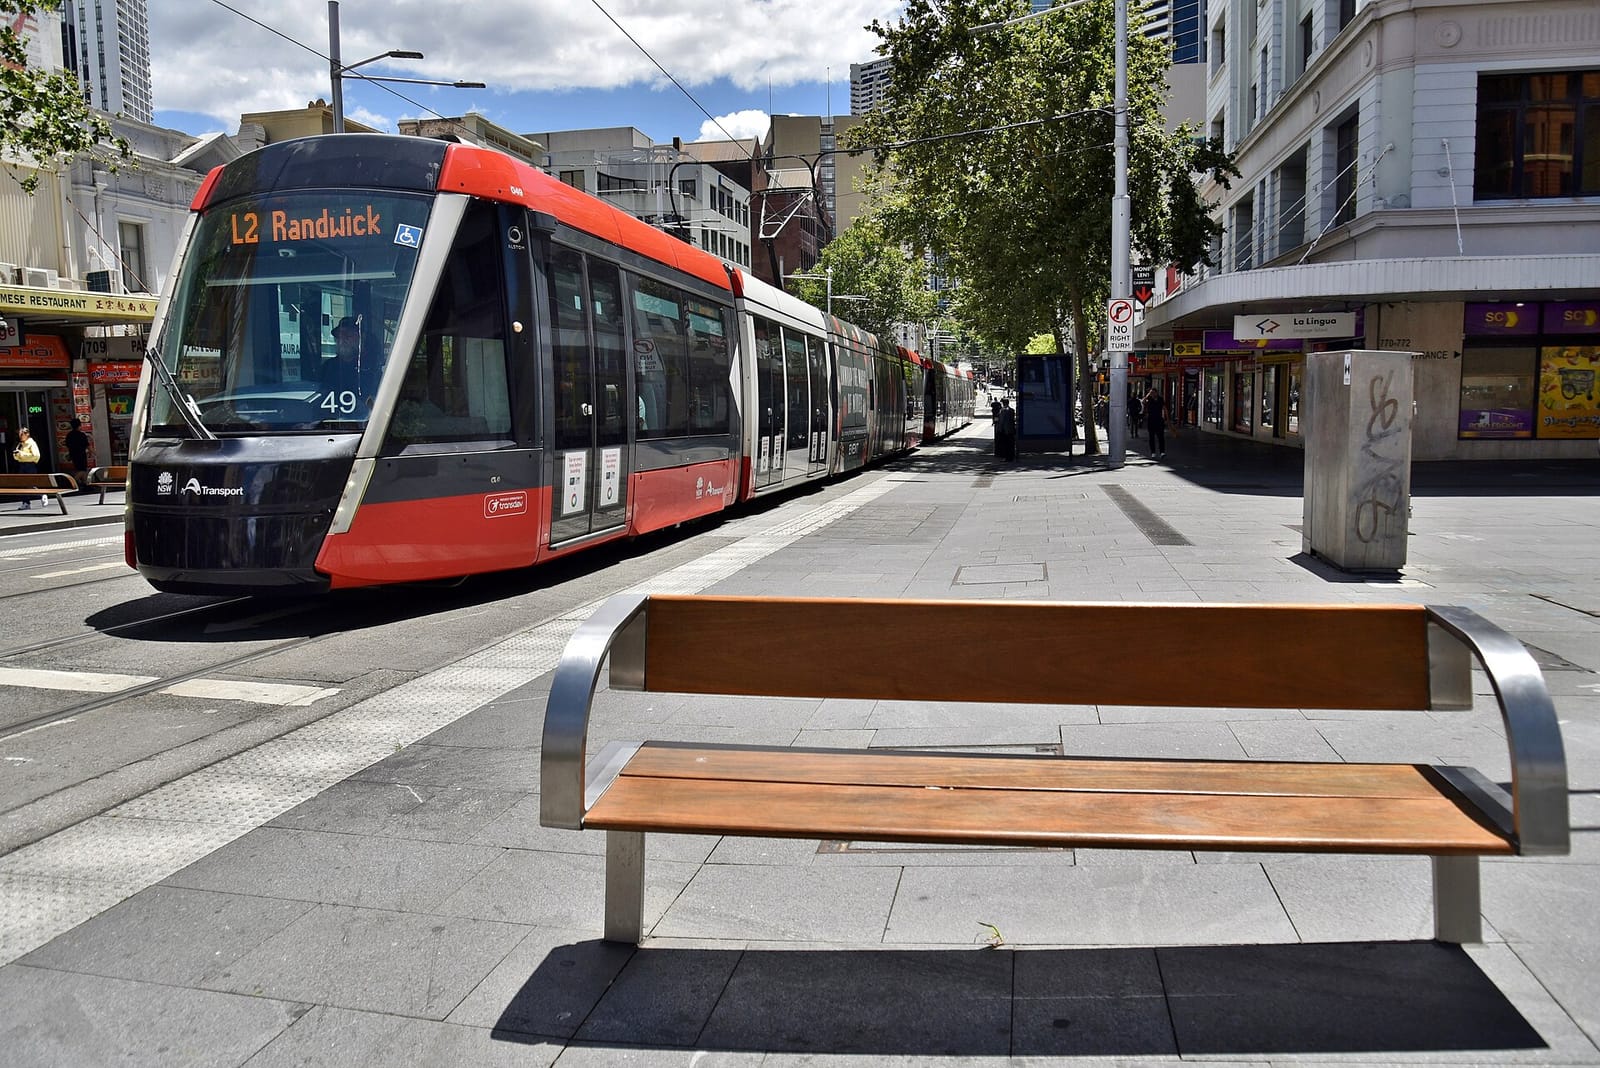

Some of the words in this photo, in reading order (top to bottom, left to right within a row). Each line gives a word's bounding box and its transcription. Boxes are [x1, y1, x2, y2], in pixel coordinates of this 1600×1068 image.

[231, 212, 259, 245] L2
[272, 204, 382, 242] Randwick
[0, 293, 26, 305] MESE
[30, 295, 87, 309] RESTAURANT
[1293, 318, 1305, 326] La
[1306, 316, 1337, 327] Lingua
[1113, 325, 1128, 334] NO
[86, 340, 106, 354] 709
[320, 390, 357, 414] 49
[157, 484, 172, 493] NSW
[201, 485, 244, 497] Transport
